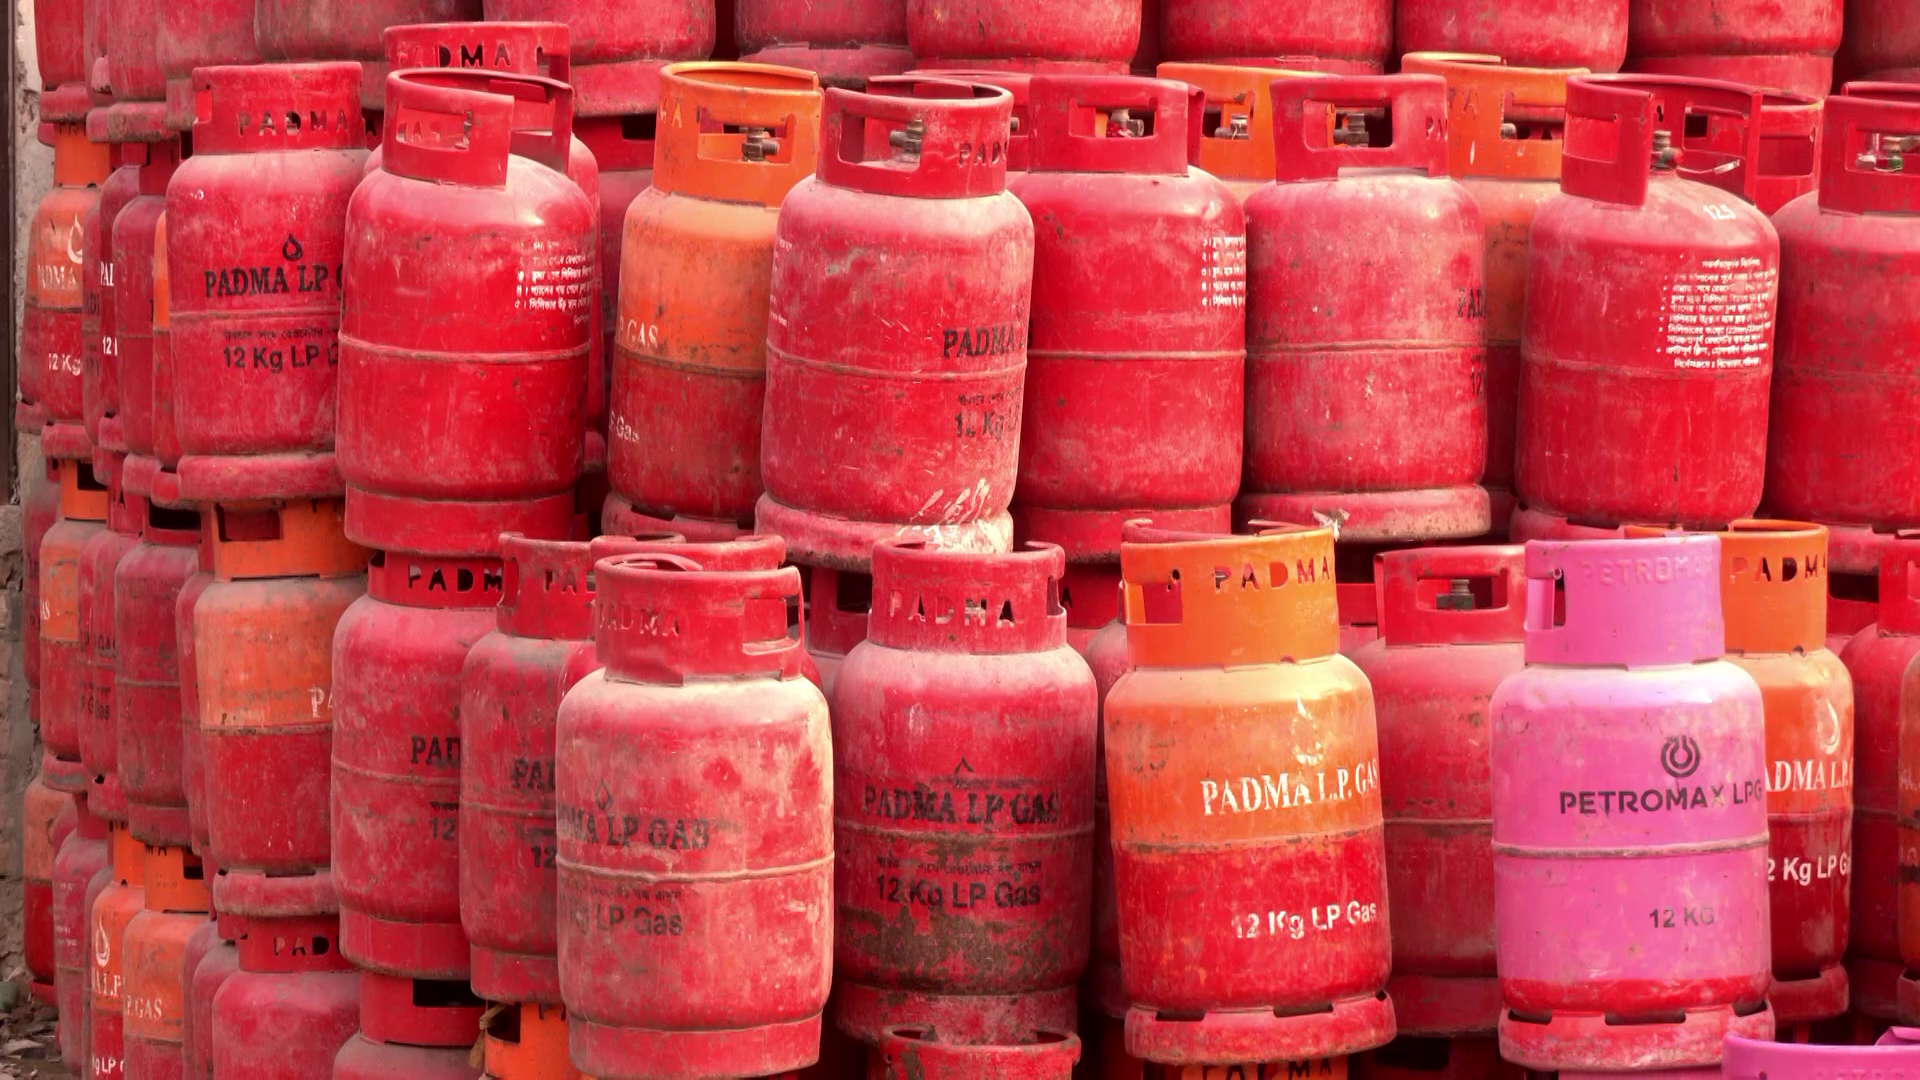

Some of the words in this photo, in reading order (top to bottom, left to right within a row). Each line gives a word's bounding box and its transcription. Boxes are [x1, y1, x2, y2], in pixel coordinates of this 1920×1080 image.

[238, 110, 349, 136] PADMA
[958, 141, 1007, 168] PAD
[204, 266, 289, 298] PADMA
[297, 264, 329, 292] LP
[627, 319, 658, 348] GAS
[943, 325, 1015, 358] PADMA
[224, 346, 245, 369] 12
[253, 346, 283, 374] Kg
[291, 344, 320, 368] LP
[408, 564, 502, 592] PADM
[1213, 555, 1330, 593] PADMA
[890, 590, 1015, 628] PADMA
[863, 785, 956, 823] PADMA
[967, 793, 1003, 823] LP
[1010, 789, 1060, 824] GAS
[1200, 772, 1312, 816] PADMA
[1560, 784, 1724, 816] PETROMAX
[1733, 779, 1762, 805] LPG
[430, 818, 456, 840] 12
[606, 814, 639, 847] LP
[531, 844, 556, 869] 12
[1783, 856, 1811, 886] Kg
[1817, 855, 1837, 878] LP
[877, 874, 901, 903] 12
[953, 882, 986, 909] LP
[995, 881, 1041, 909] Gas
[634, 906, 683, 935] Gas
[1268, 910, 1304, 940] Kg
[1312, 904, 1341, 930] LP
[1347, 900, 1376, 925] Gas
[1650, 906, 1675, 928] 12
[1684, 906, 1715, 926] KG
[274, 934, 339, 956] PAD
[135, 997, 162, 1019] GAS
[101, 1056, 116, 1075] LP
